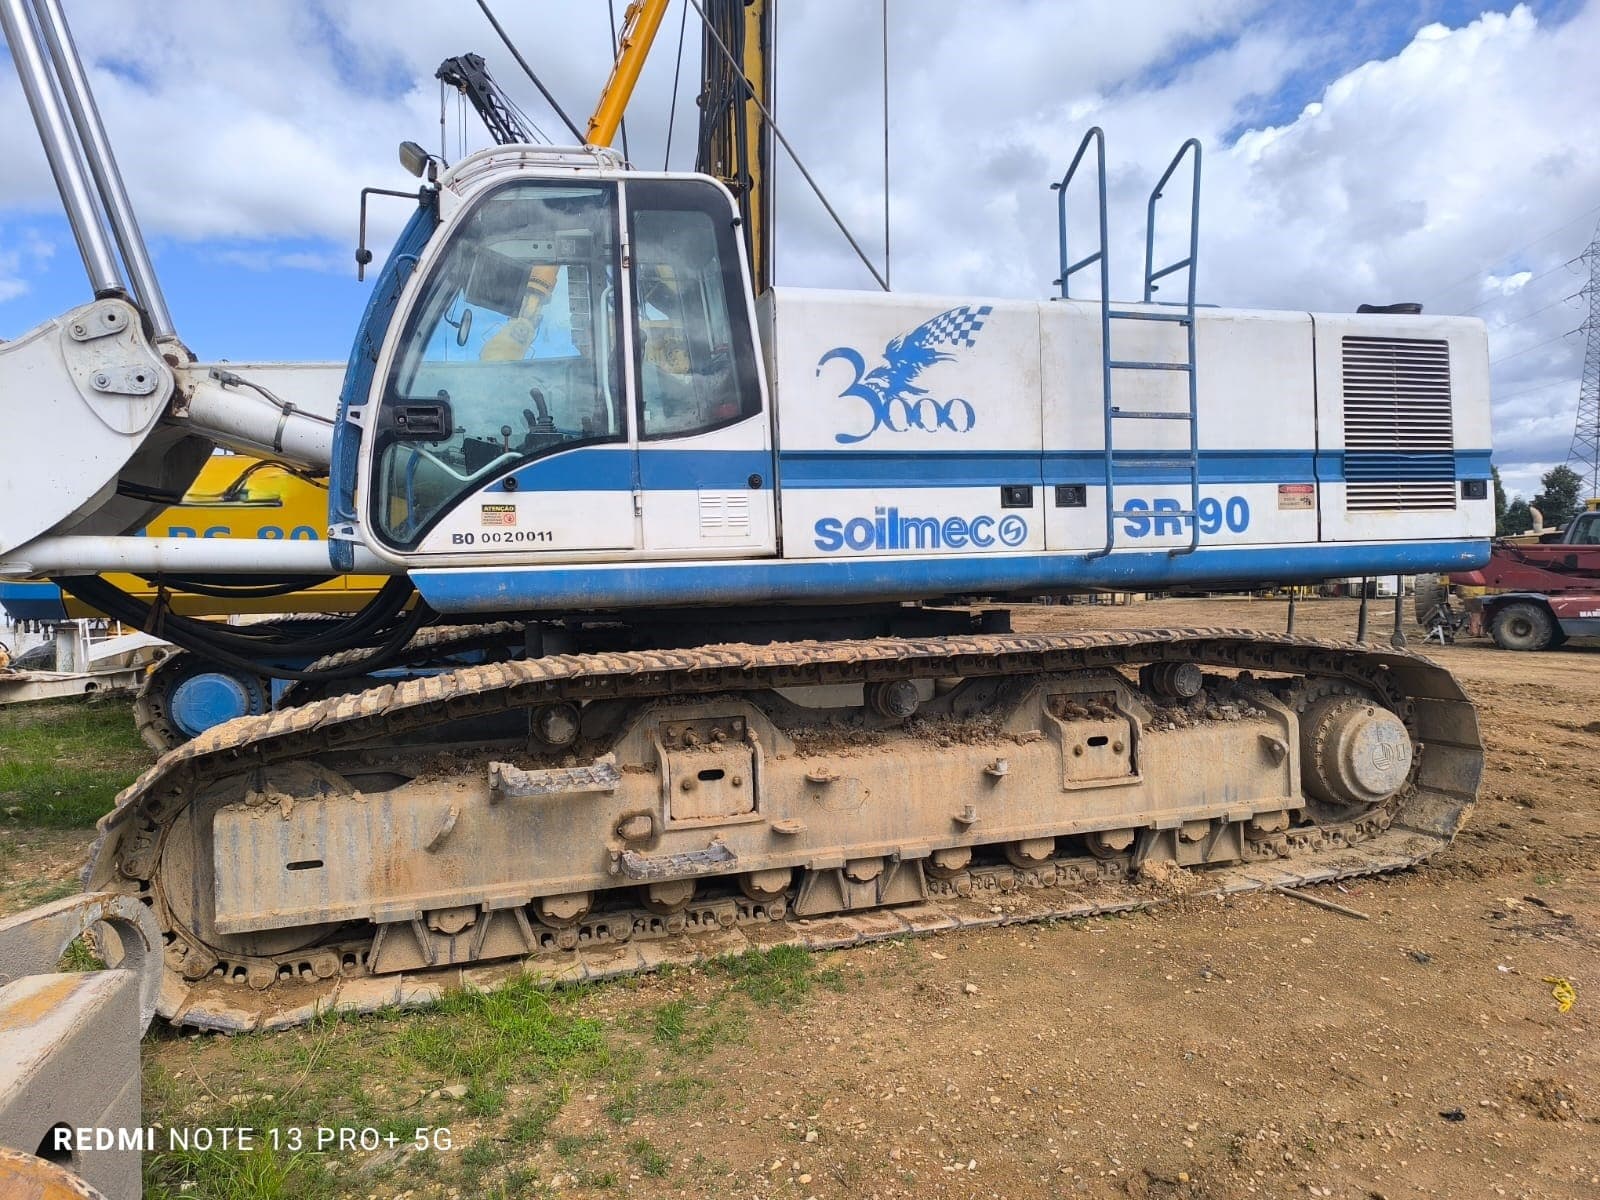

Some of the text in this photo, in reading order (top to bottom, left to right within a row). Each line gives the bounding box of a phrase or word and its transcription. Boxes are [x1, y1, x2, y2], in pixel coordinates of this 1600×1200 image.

[815, 347, 976, 444] 3000
[484, 505, 514, 513] ATENÇÃO
[481, 531, 553, 543] 0020011
[814, 506, 996, 551] soilmec
